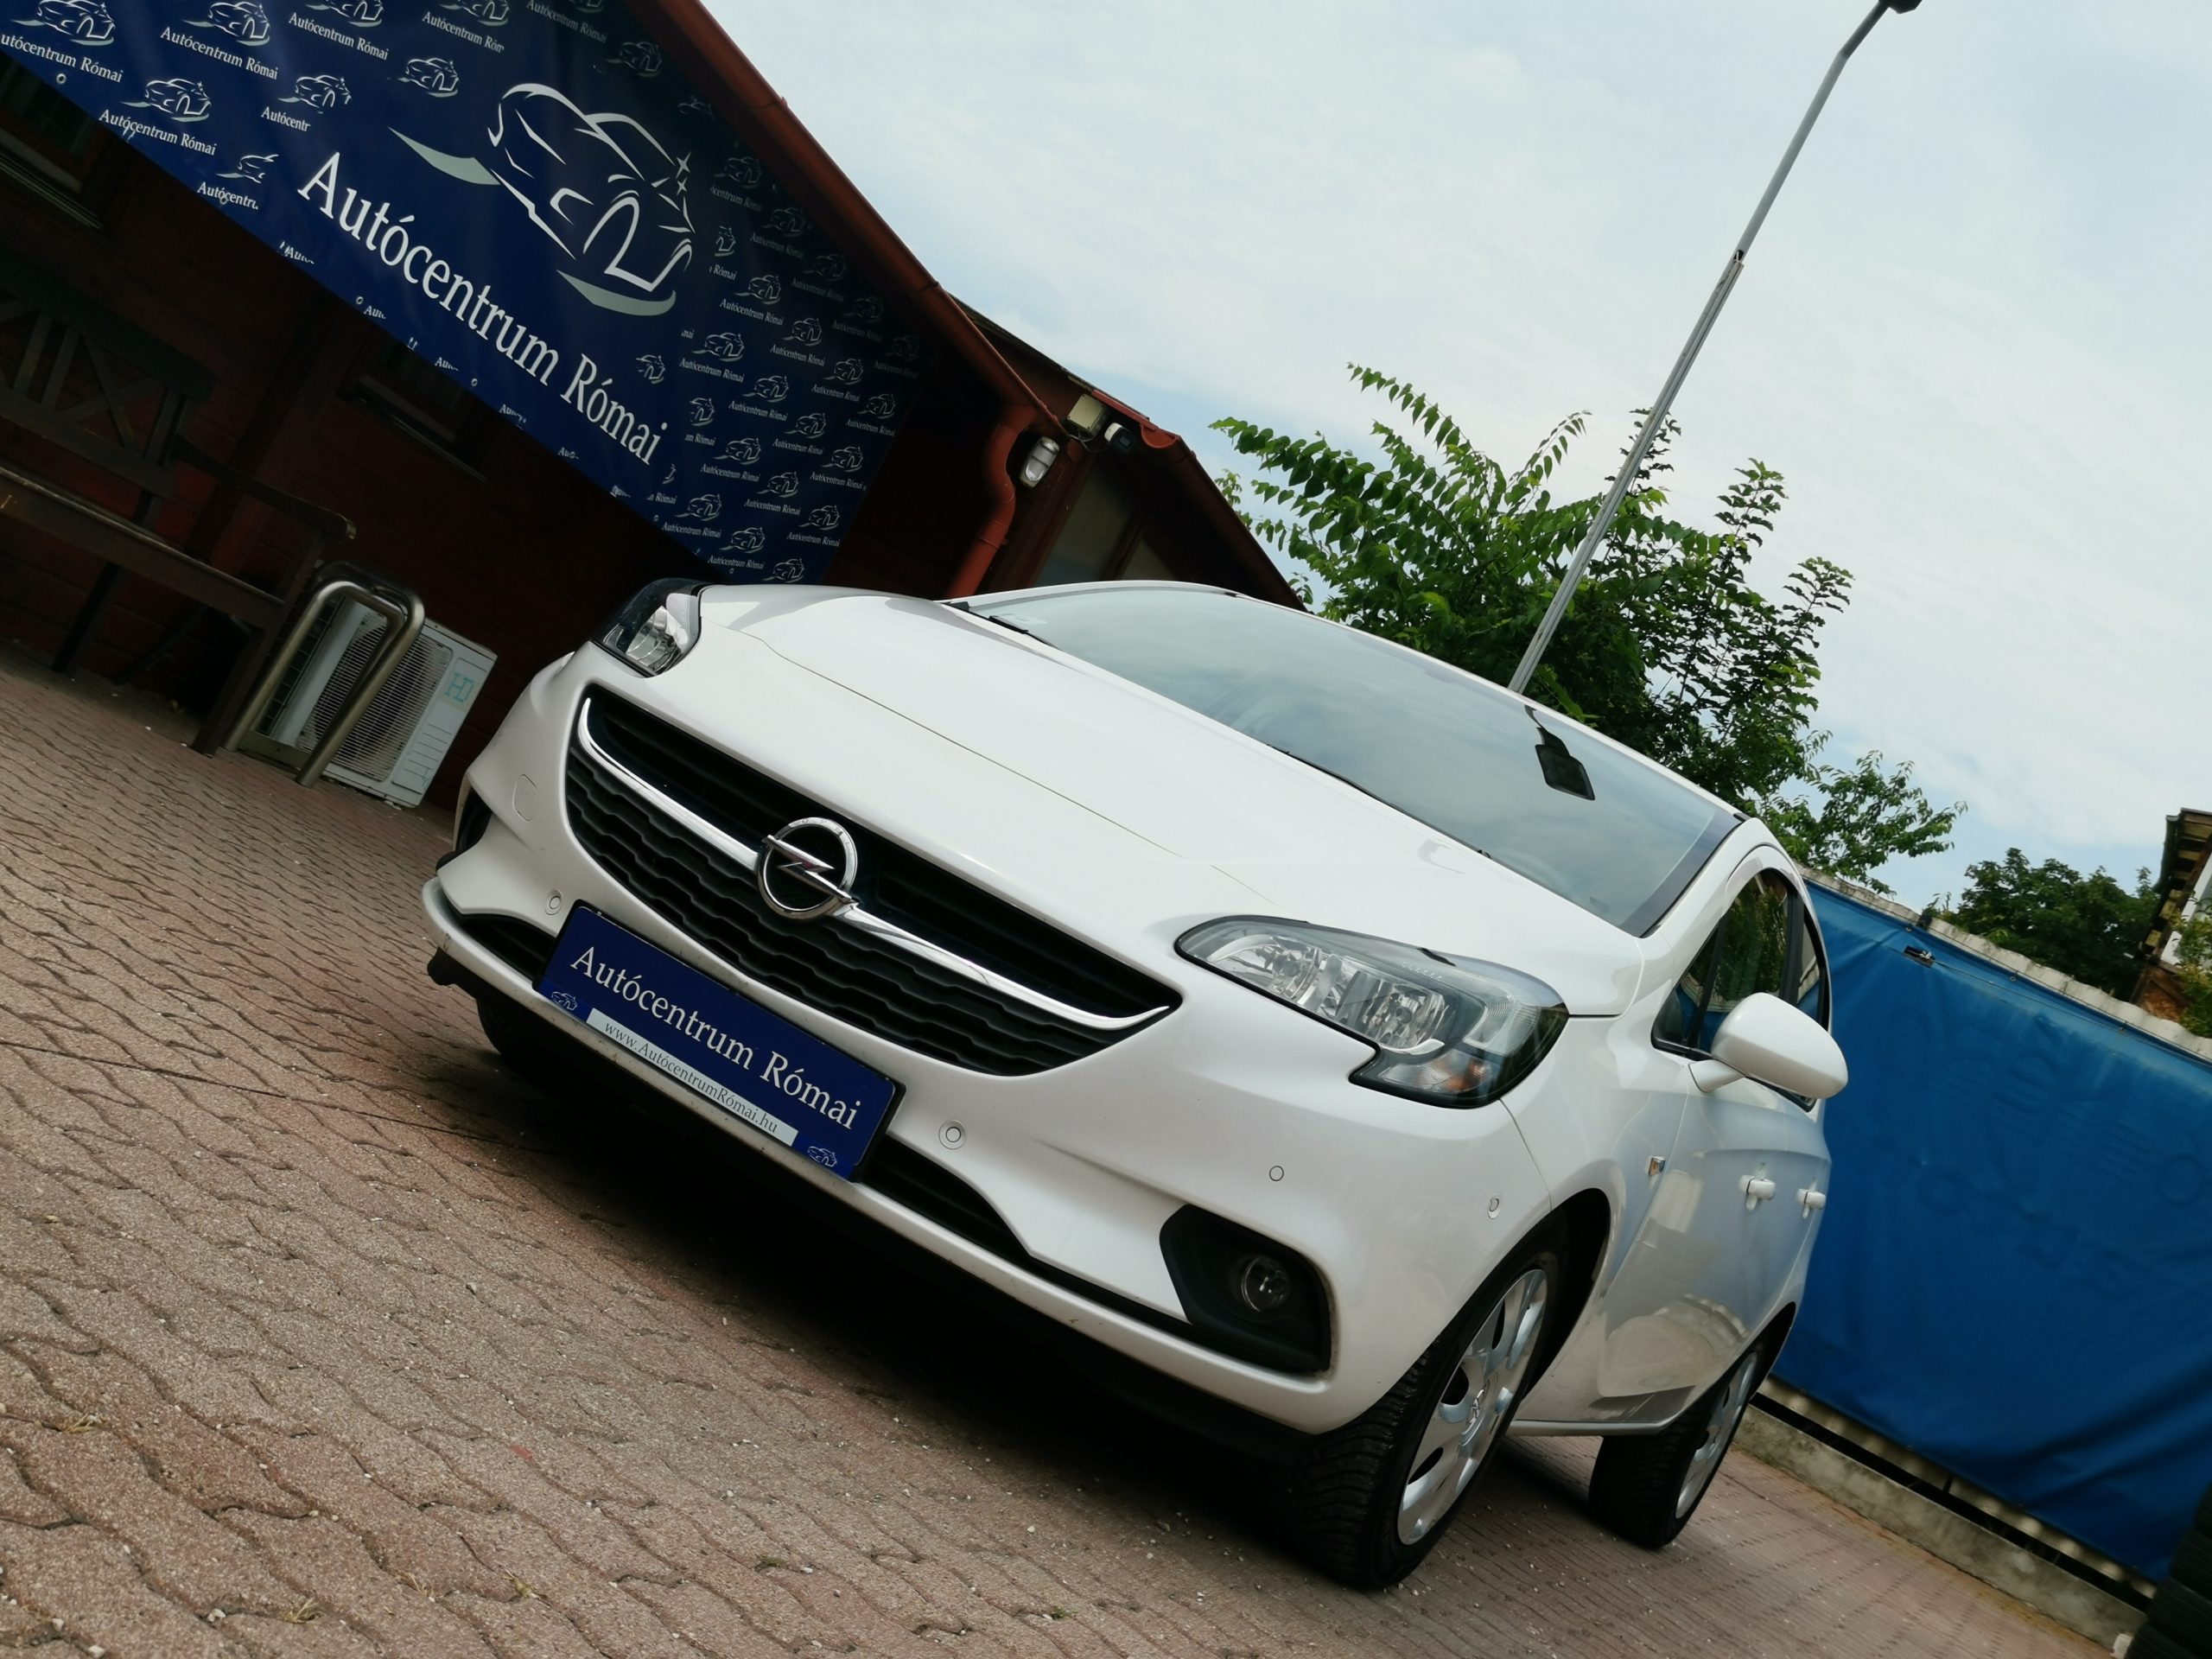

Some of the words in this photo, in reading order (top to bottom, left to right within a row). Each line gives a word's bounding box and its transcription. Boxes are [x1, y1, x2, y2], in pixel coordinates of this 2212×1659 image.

[289, 12, 354, 48] Autócentrum
[357, 37, 389, 60] Római
[423, 12, 482, 46] Autócentrum
[0, 34, 76, 67] utócentrum
[81, 57, 124, 83] Római
[161, 27, 242, 67] Autócentrum
[246, 60, 277, 79] Római
[99, 109, 177, 143] Autócentrum
[181, 134, 217, 156] Római
[261, 106, 311, 132] Autócentr
[714, 264, 737, 281] Római
[297, 151, 559, 385] Autócentrum
[560, 353, 668, 466] Római
[720, 298, 764, 321] Autócentrum
[765, 311, 785, 326] Római
[679, 358, 721, 378] Autócentrum
[723, 367, 746, 384] Római
[570, 946, 754, 1071] Autócentrum
[760, 1051, 862, 1129] Római
[604, 1020, 779, 1135] www.AutócentrumRómai.hu
